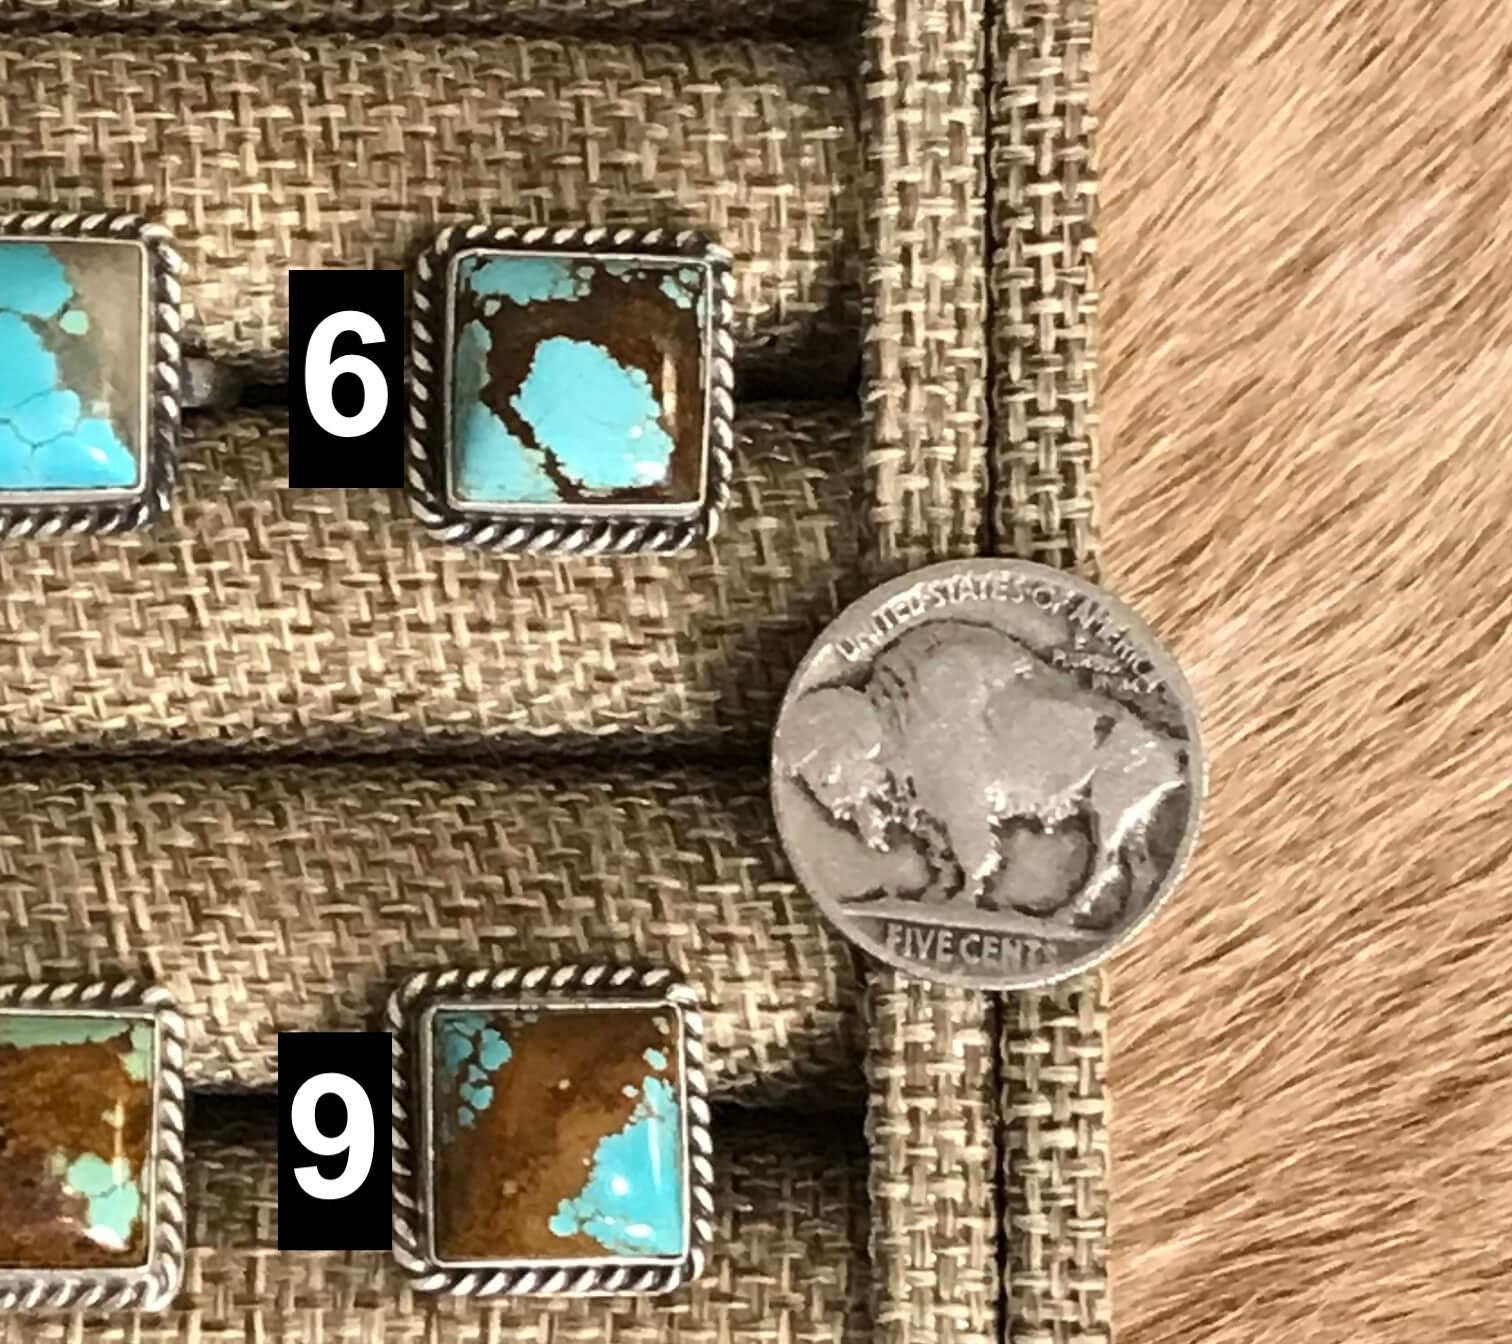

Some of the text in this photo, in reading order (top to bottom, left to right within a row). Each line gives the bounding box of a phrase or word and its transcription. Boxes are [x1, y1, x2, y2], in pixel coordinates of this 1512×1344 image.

[836, 582, 926, 662] UNITED
[927, 570, 1025, 607] STATES
[886, 923, 954, 963] FIVE
